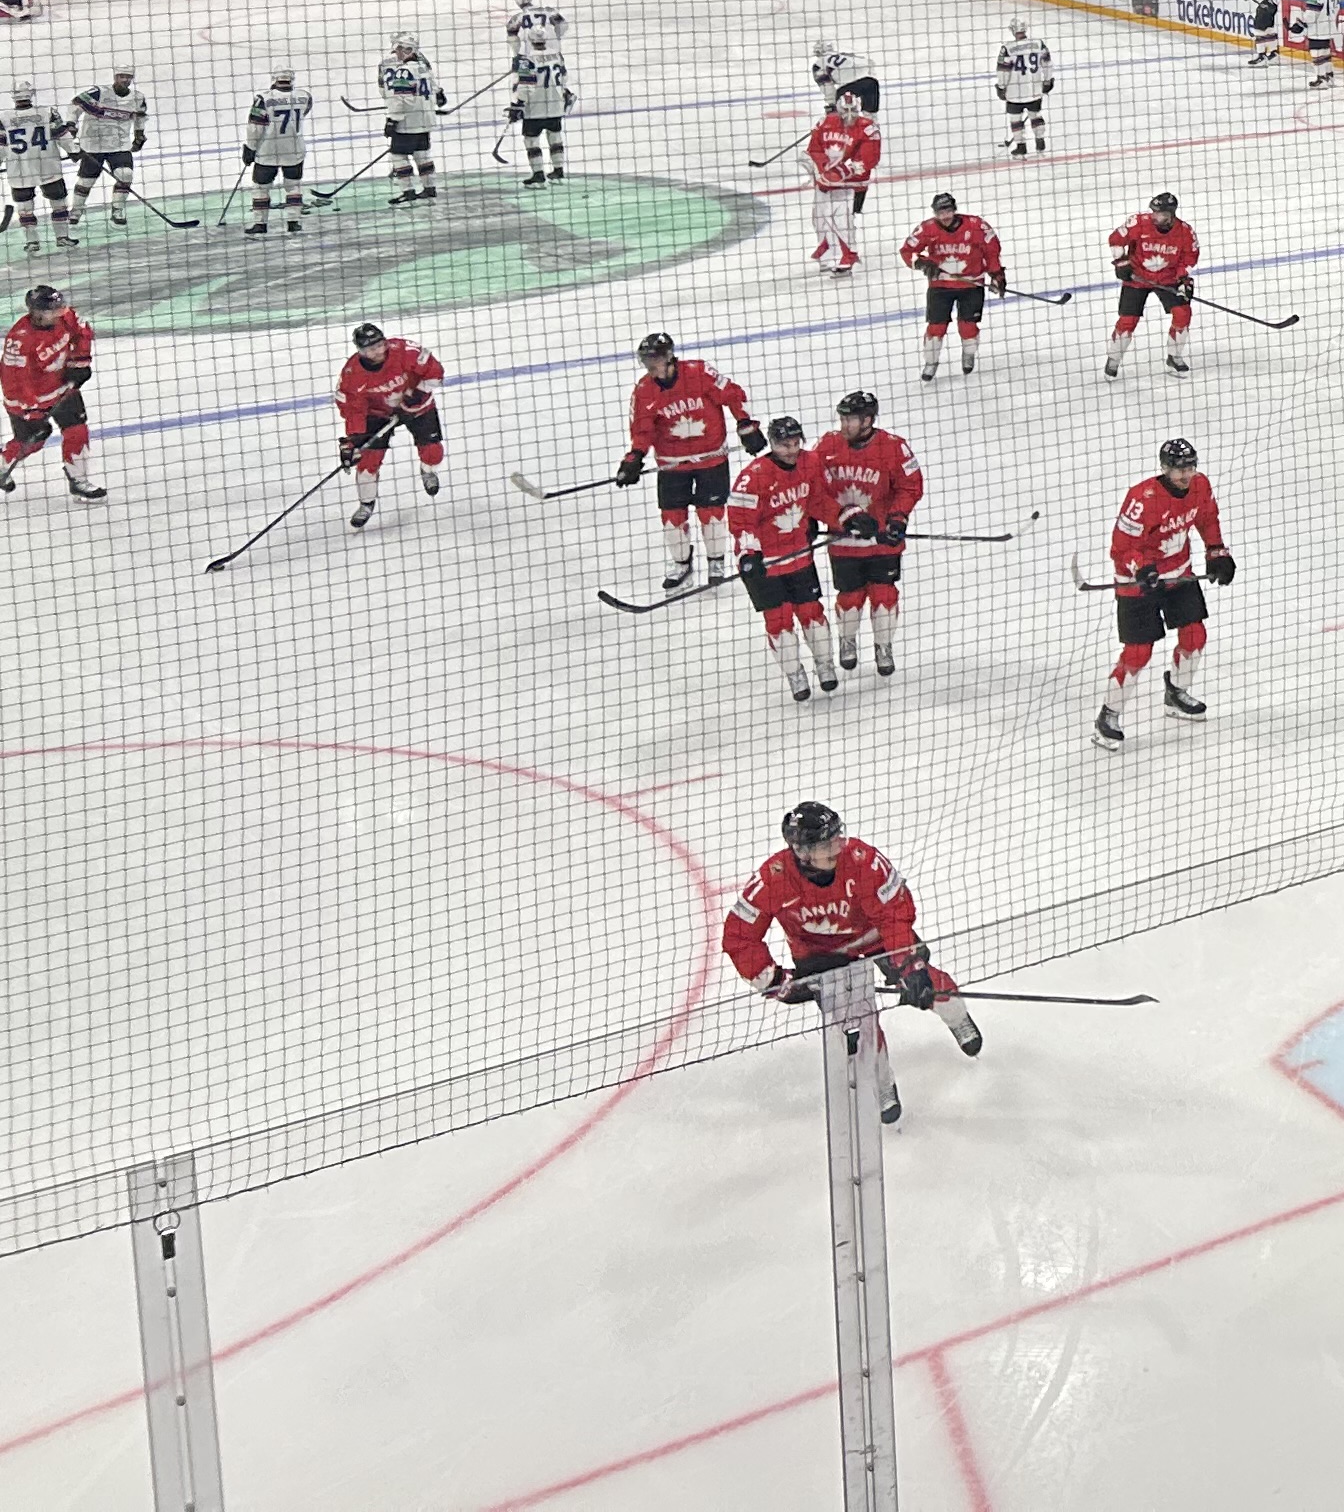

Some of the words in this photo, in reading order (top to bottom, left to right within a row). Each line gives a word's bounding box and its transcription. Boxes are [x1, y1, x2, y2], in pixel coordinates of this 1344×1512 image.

[1014, 53, 1039, 75] 49
[8, 125, 49, 154] 54
[1125, 498, 1145, 521] 13
